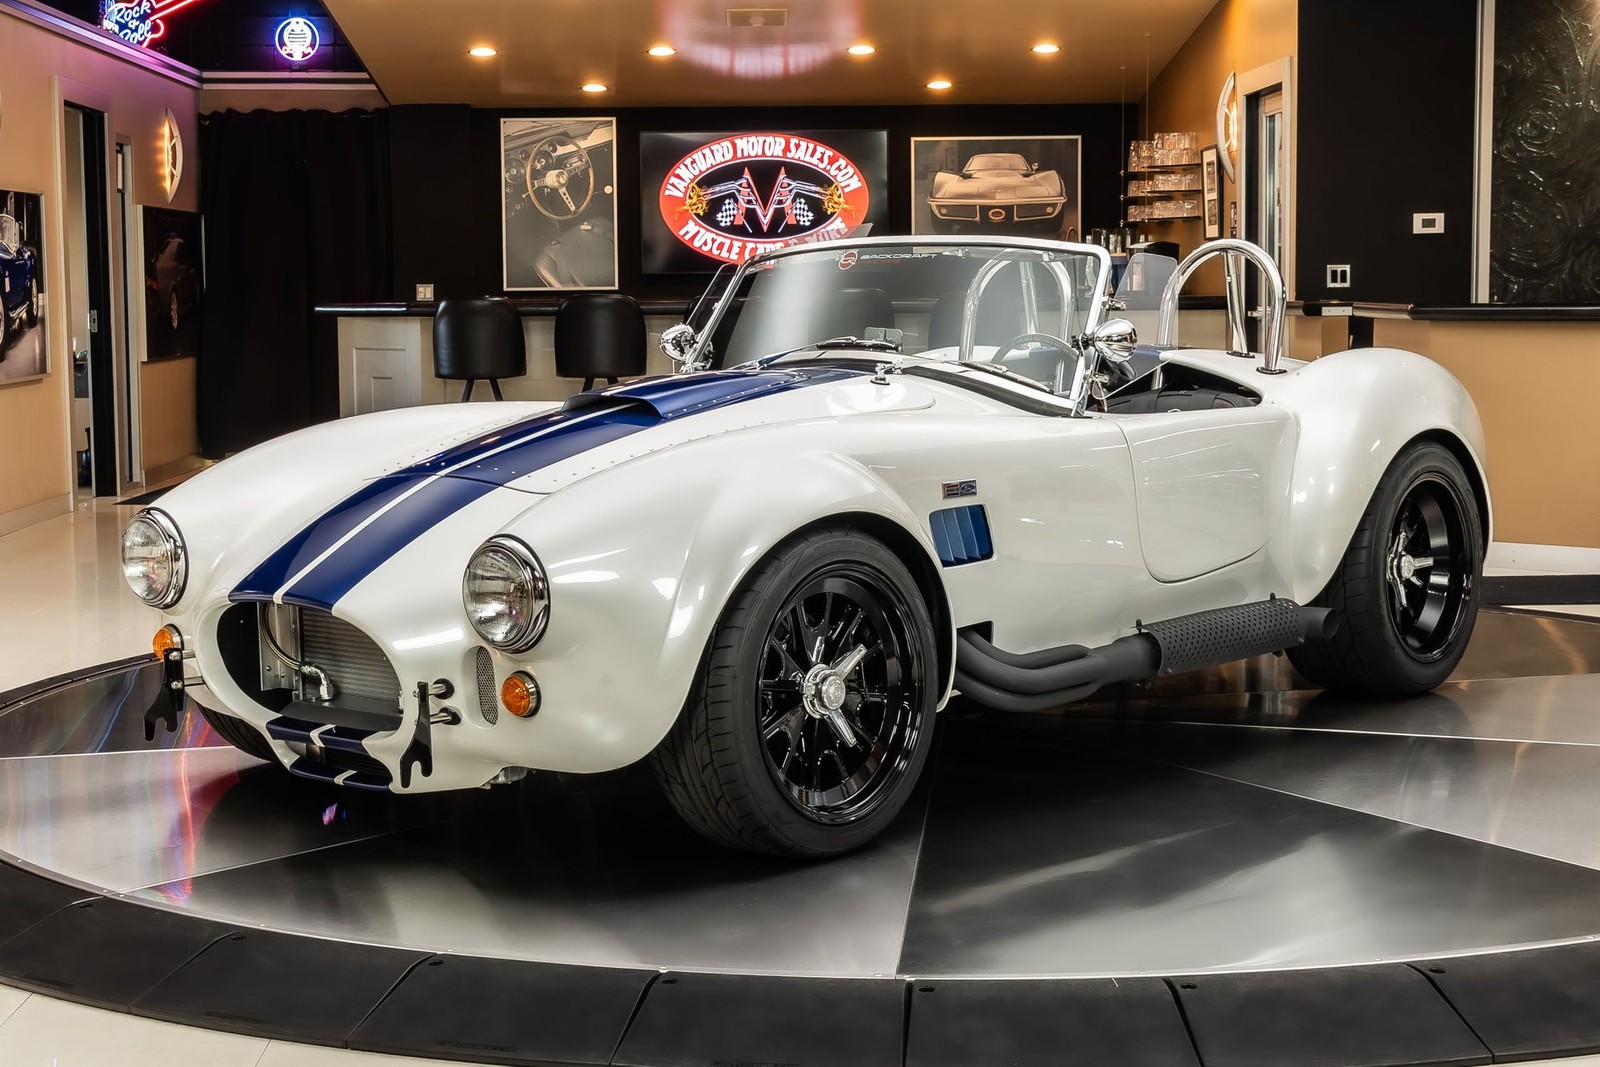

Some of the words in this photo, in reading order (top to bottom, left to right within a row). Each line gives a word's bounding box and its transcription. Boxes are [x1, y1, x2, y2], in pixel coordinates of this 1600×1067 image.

[114, 0, 151, 23] Rock
[664, 139, 734, 198] VANGUARD
[734, 135, 786, 158] MOTOR
[787, 138, 863, 193] SALES.COM
[678, 219, 749, 261] MUSCLE
[744, 242, 784, 262] CAR
